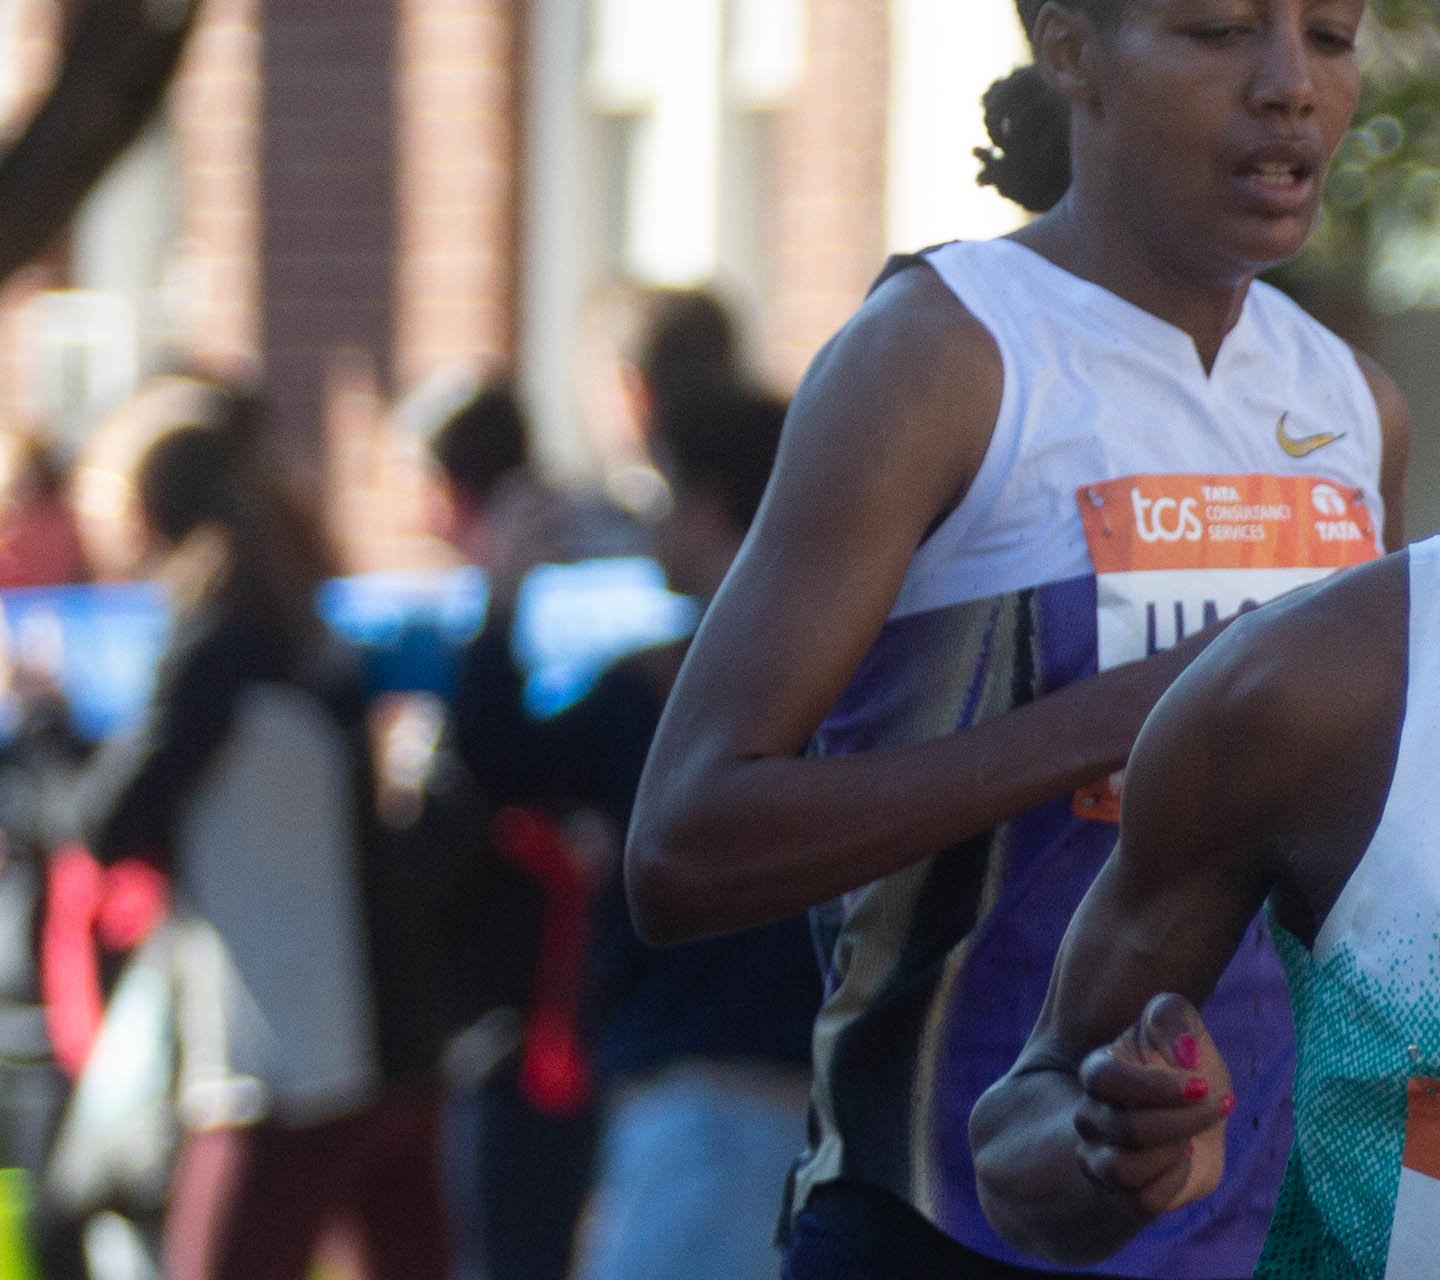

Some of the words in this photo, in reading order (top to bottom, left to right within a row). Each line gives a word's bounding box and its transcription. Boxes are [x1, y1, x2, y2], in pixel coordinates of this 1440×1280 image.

[1202, 486, 1240, 502] TATA
[1131, 487, 1202, 543] tcs
[1208, 525, 1265, 541] SERVICES
[1316, 522, 1362, 541] TATA
